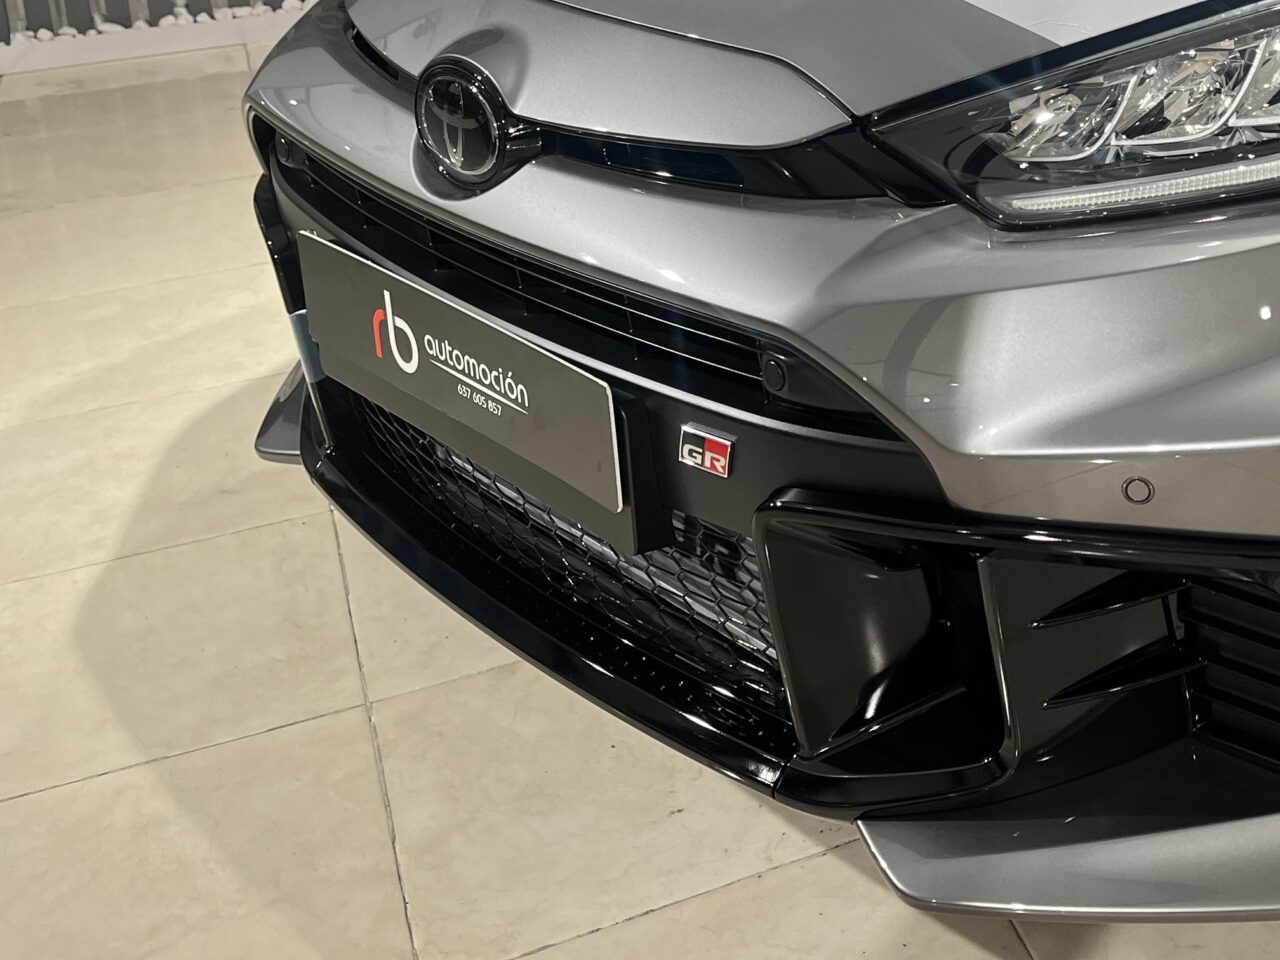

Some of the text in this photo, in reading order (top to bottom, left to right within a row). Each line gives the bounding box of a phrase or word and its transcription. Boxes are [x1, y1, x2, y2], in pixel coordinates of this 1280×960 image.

[372, 289, 419, 374] rb
[423, 333, 529, 407] automoción
[457, 383, 502, 416] 637 605 857
[682, 443, 726, 474] GR
